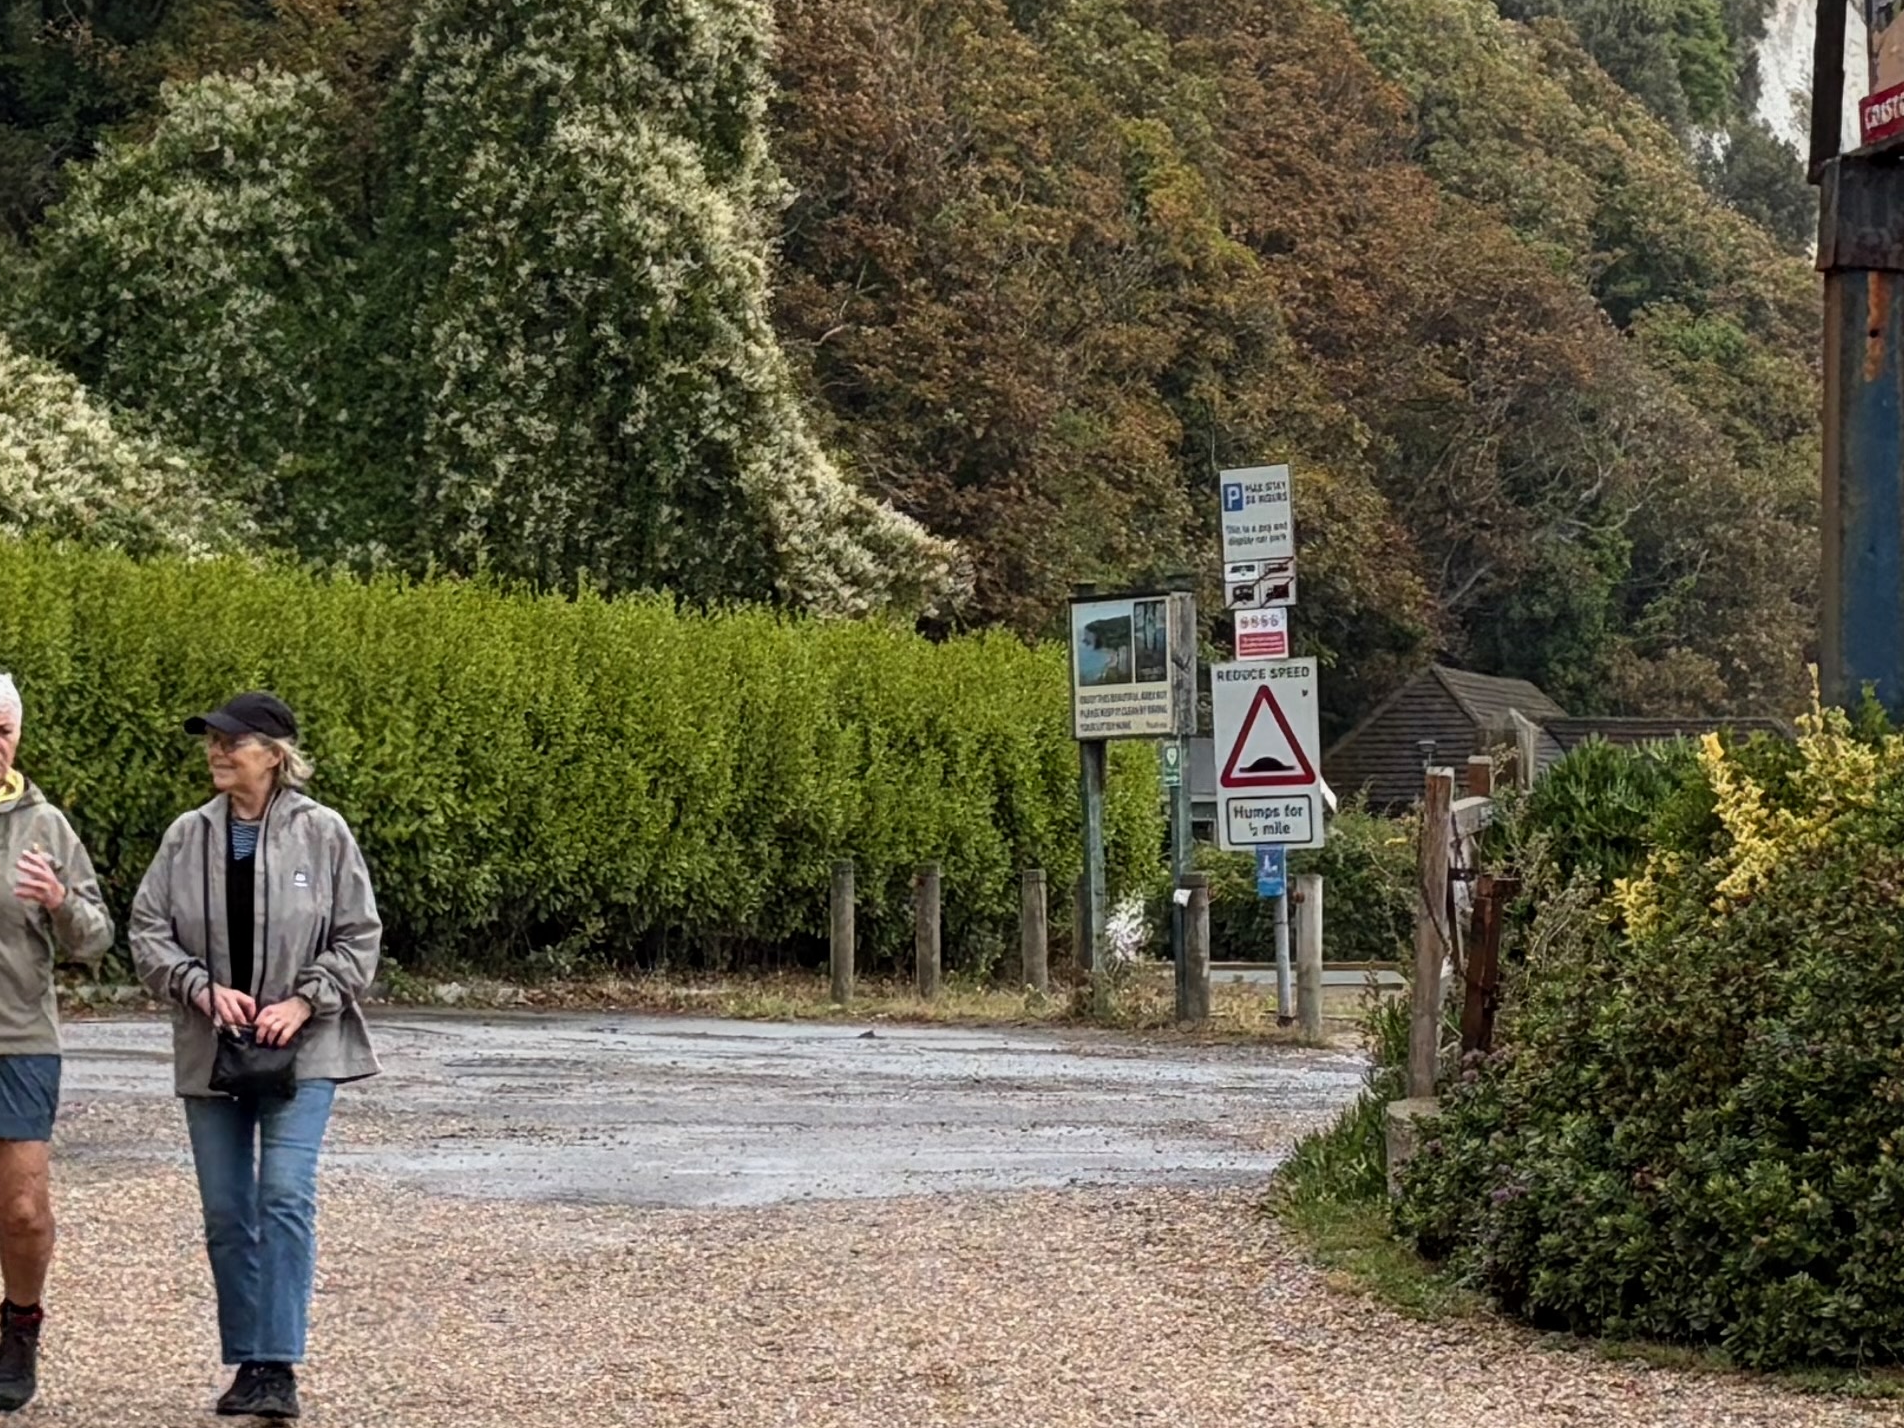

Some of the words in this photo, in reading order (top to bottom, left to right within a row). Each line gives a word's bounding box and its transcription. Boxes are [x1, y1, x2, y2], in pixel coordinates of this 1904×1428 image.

[1217, 669, 1266, 682] REDUCE
[1270, 666, 1310, 679] SPEED
[1234, 805, 1281, 820] Humps
[1284, 804, 1304, 817] for
[1263, 821, 1291, 835] mile
